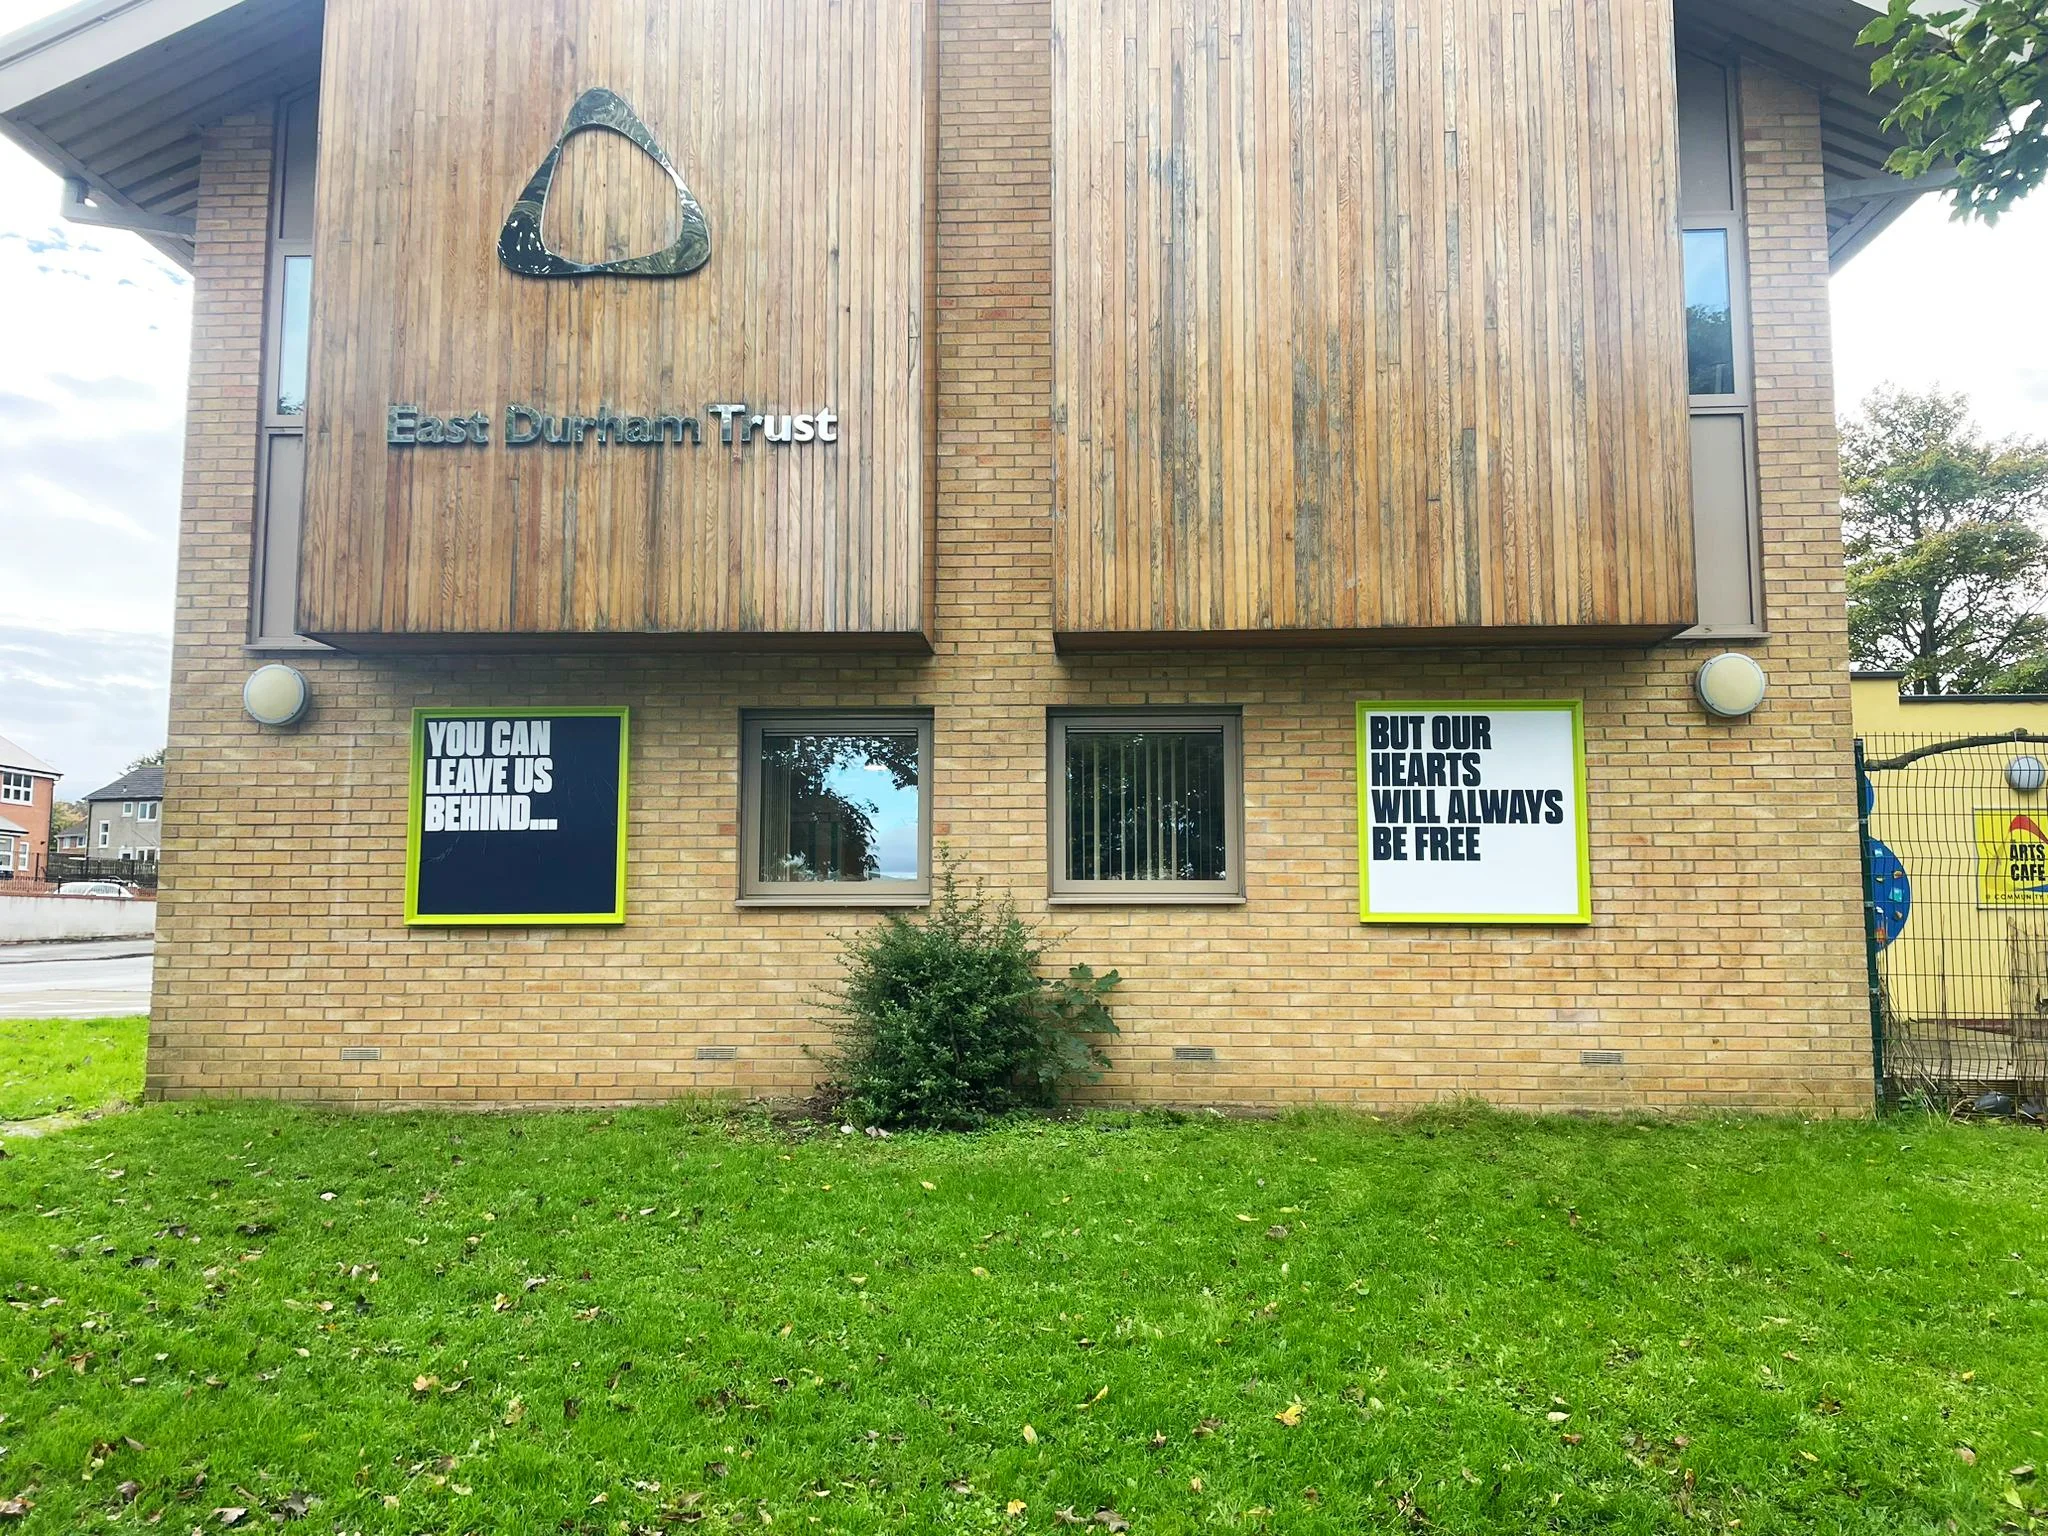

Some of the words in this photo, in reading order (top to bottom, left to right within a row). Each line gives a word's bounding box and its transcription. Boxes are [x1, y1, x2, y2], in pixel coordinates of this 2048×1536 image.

[387, 405, 490, 443] East
[505, 405, 700, 443] Durham
[708, 404, 838, 443] Trust
[427, 721, 486, 757] YOU
[492, 720, 551, 756] CAN
[1370, 715, 1425, 750] BUT
[1431, 715, 1492, 750] OUR
[426, 758, 509, 794] LEAVE
[514, 757, 554, 793] US
[1371, 752, 1481, 787] HEARTS
[425, 795, 558, 832] BEHIND...
[1371, 789, 1441, 824] WILL
[1447, 789, 1564, 824] ALWAYS
[1373, 826, 1408, 861] BE
[1415, 826, 1481, 861] FREE
[2010, 844, 2046, 861] ARTS
